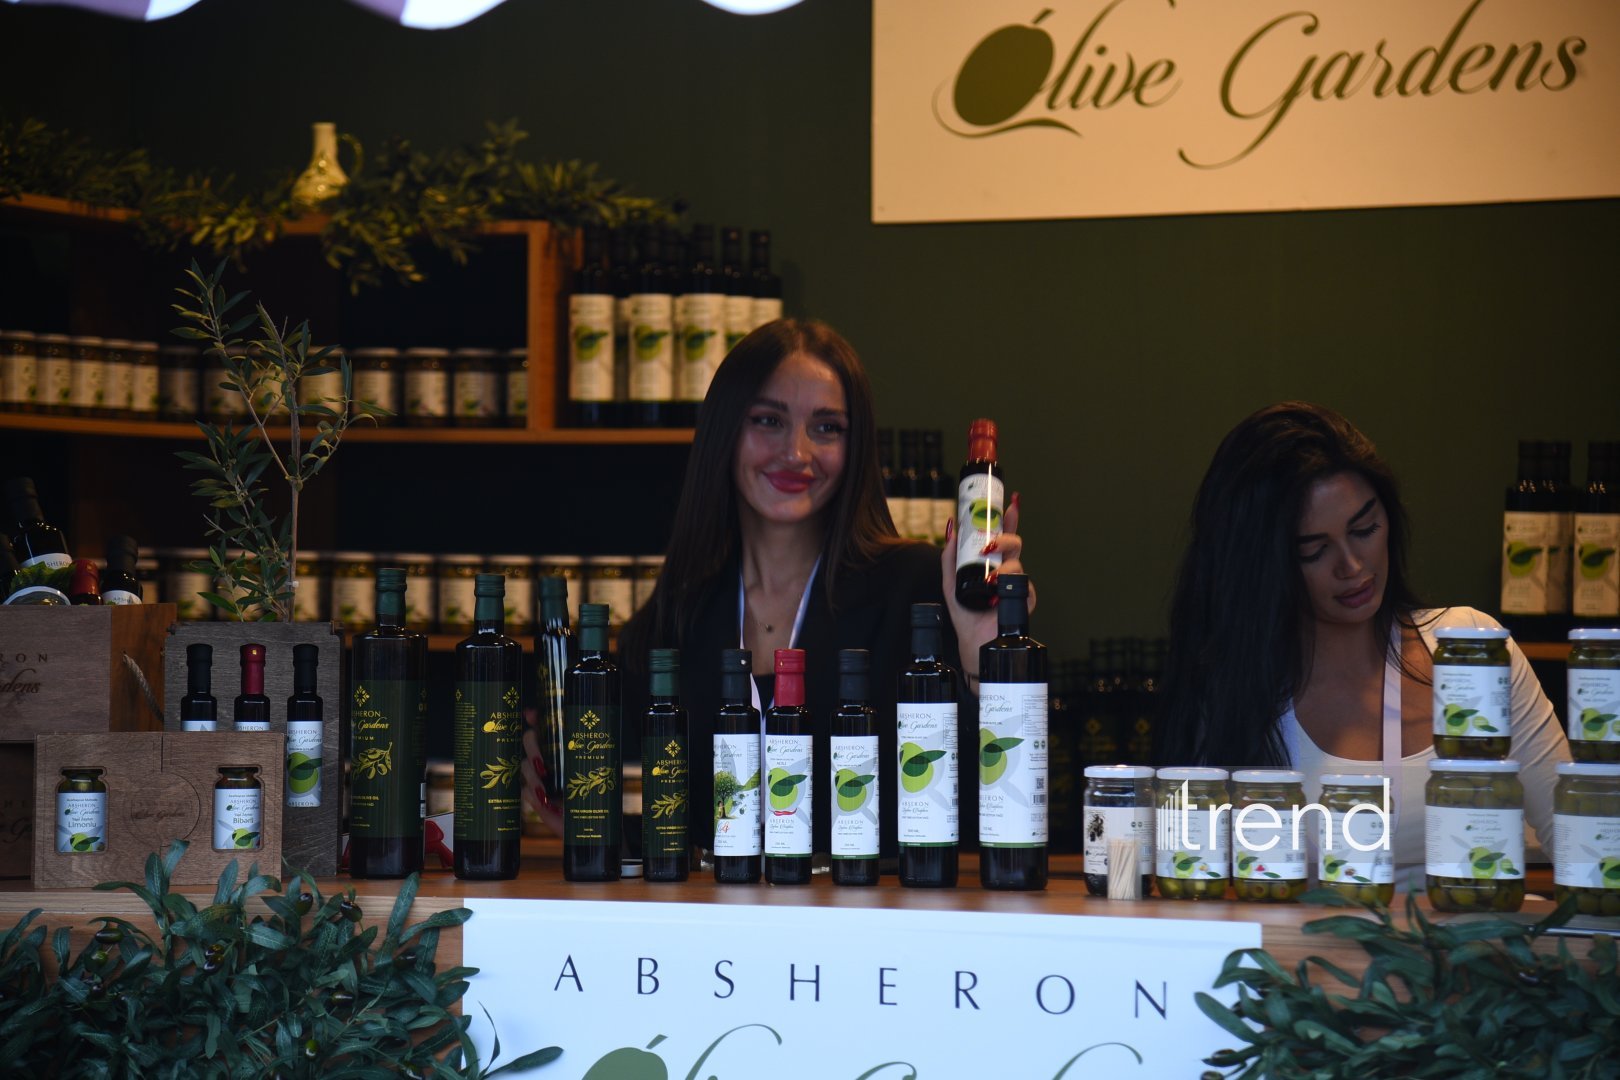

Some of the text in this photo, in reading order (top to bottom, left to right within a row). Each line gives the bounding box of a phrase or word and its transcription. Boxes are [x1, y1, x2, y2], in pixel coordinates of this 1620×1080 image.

[931, 0, 1586, 169] Olive Gardens
[357, 716, 390, 734] Gardens
[909, 718, 937, 733] Gardens
[554, 954, 1166, 1020] ABSHERON
